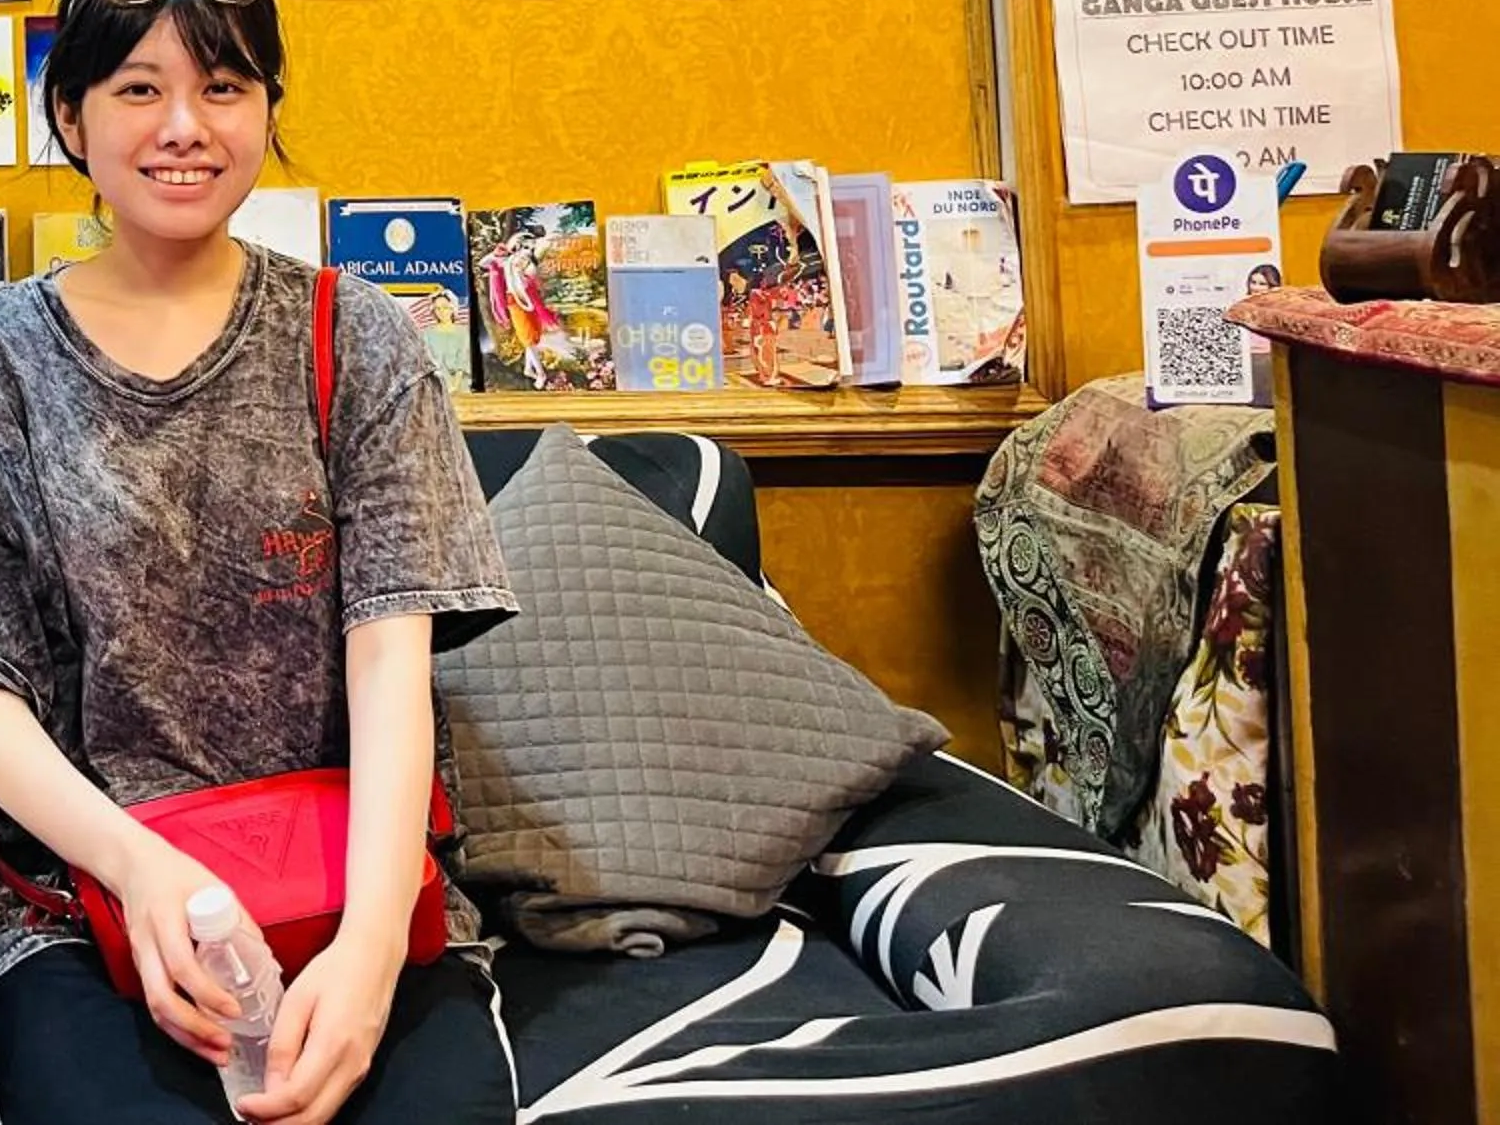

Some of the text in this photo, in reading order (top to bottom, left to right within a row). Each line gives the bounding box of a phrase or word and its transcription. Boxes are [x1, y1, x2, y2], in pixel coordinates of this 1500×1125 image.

[1127, 25, 1334, 54] CHECK OUT TIME
[1181, 67, 1291, 92] 10:00 AM
[1150, 104, 1331, 132] CHECK IN TIME
[1259, 146, 1297, 167] AM
[947, 191, 981, 201] INDE
[933, 202, 999, 213] DU NORD
[1173, 217, 1241, 231] PhonePe
[338, 260, 464, 276] ABIGAIL ADAMS
[896, 220, 929, 336] Routard
